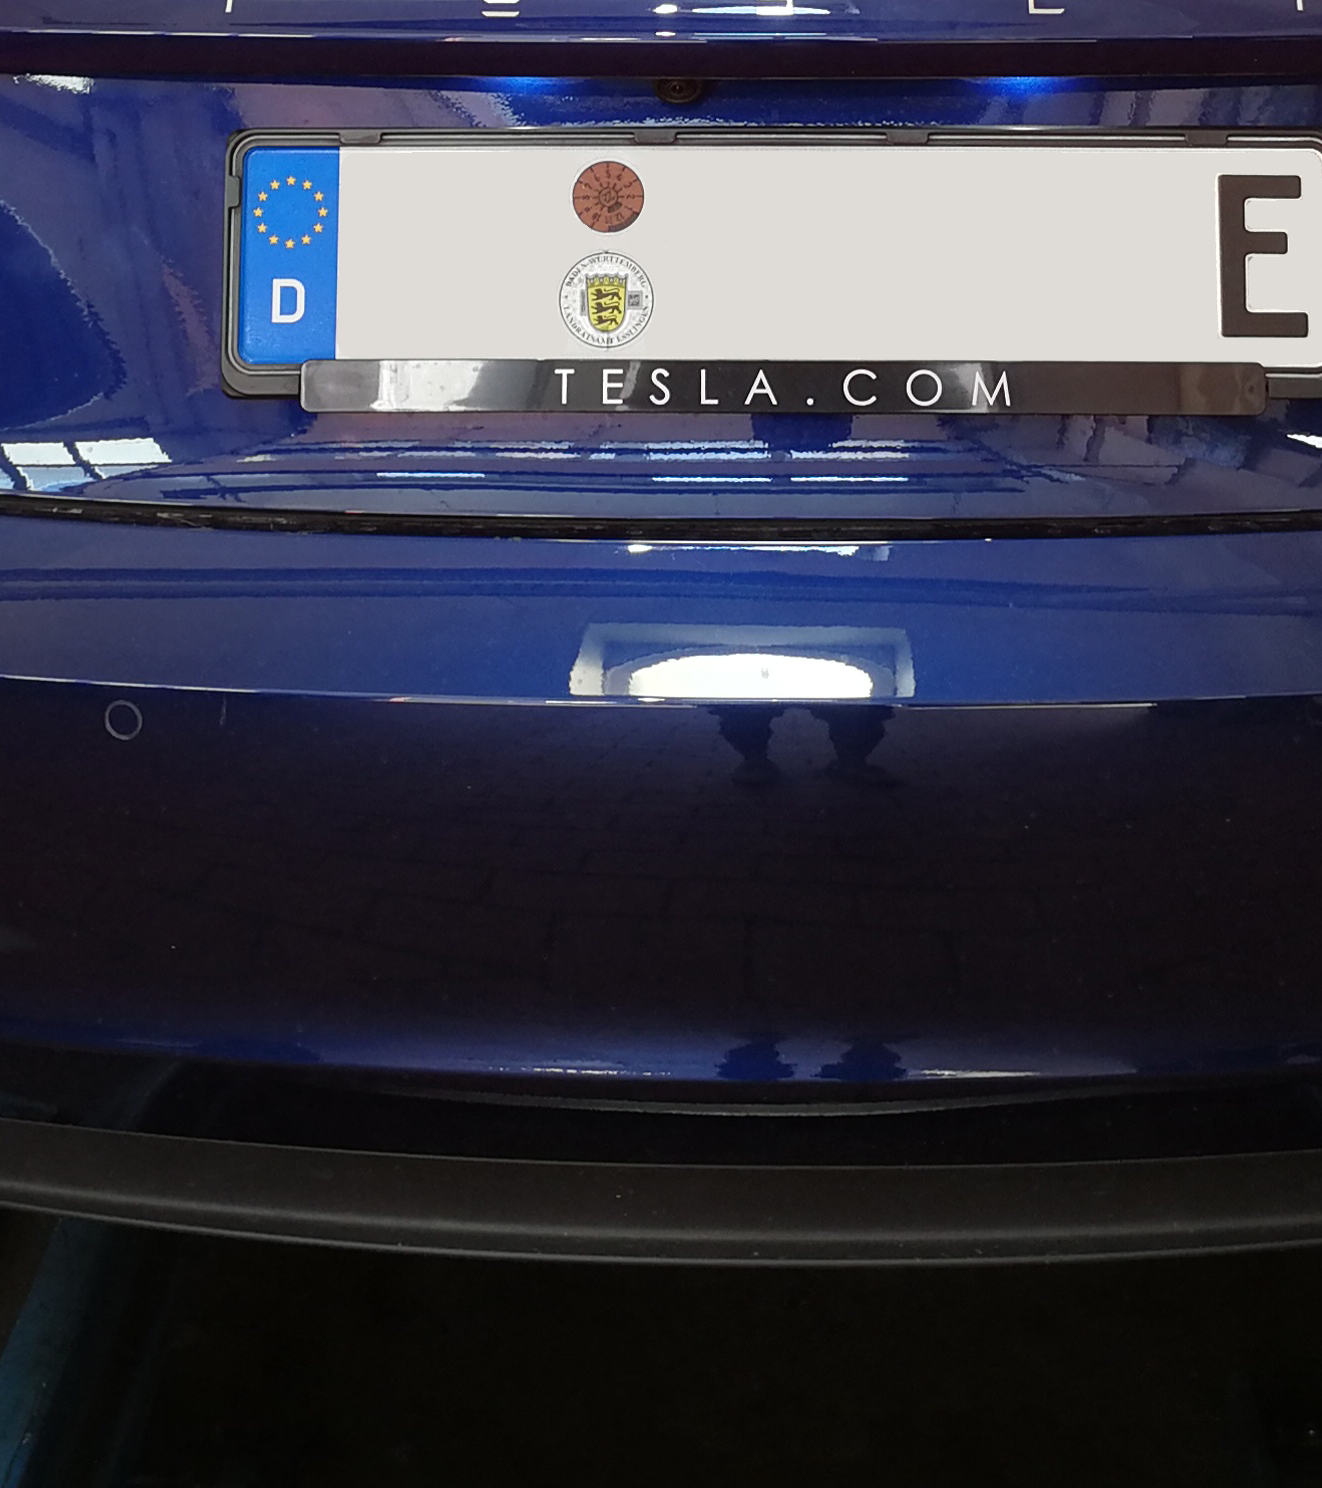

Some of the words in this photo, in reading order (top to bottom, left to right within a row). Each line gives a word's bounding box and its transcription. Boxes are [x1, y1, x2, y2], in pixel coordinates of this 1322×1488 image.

[1220, 174, 1309, 339] E
[272, 278, 306, 323] D
[554, 368, 1012, 409] TESLA.COM
